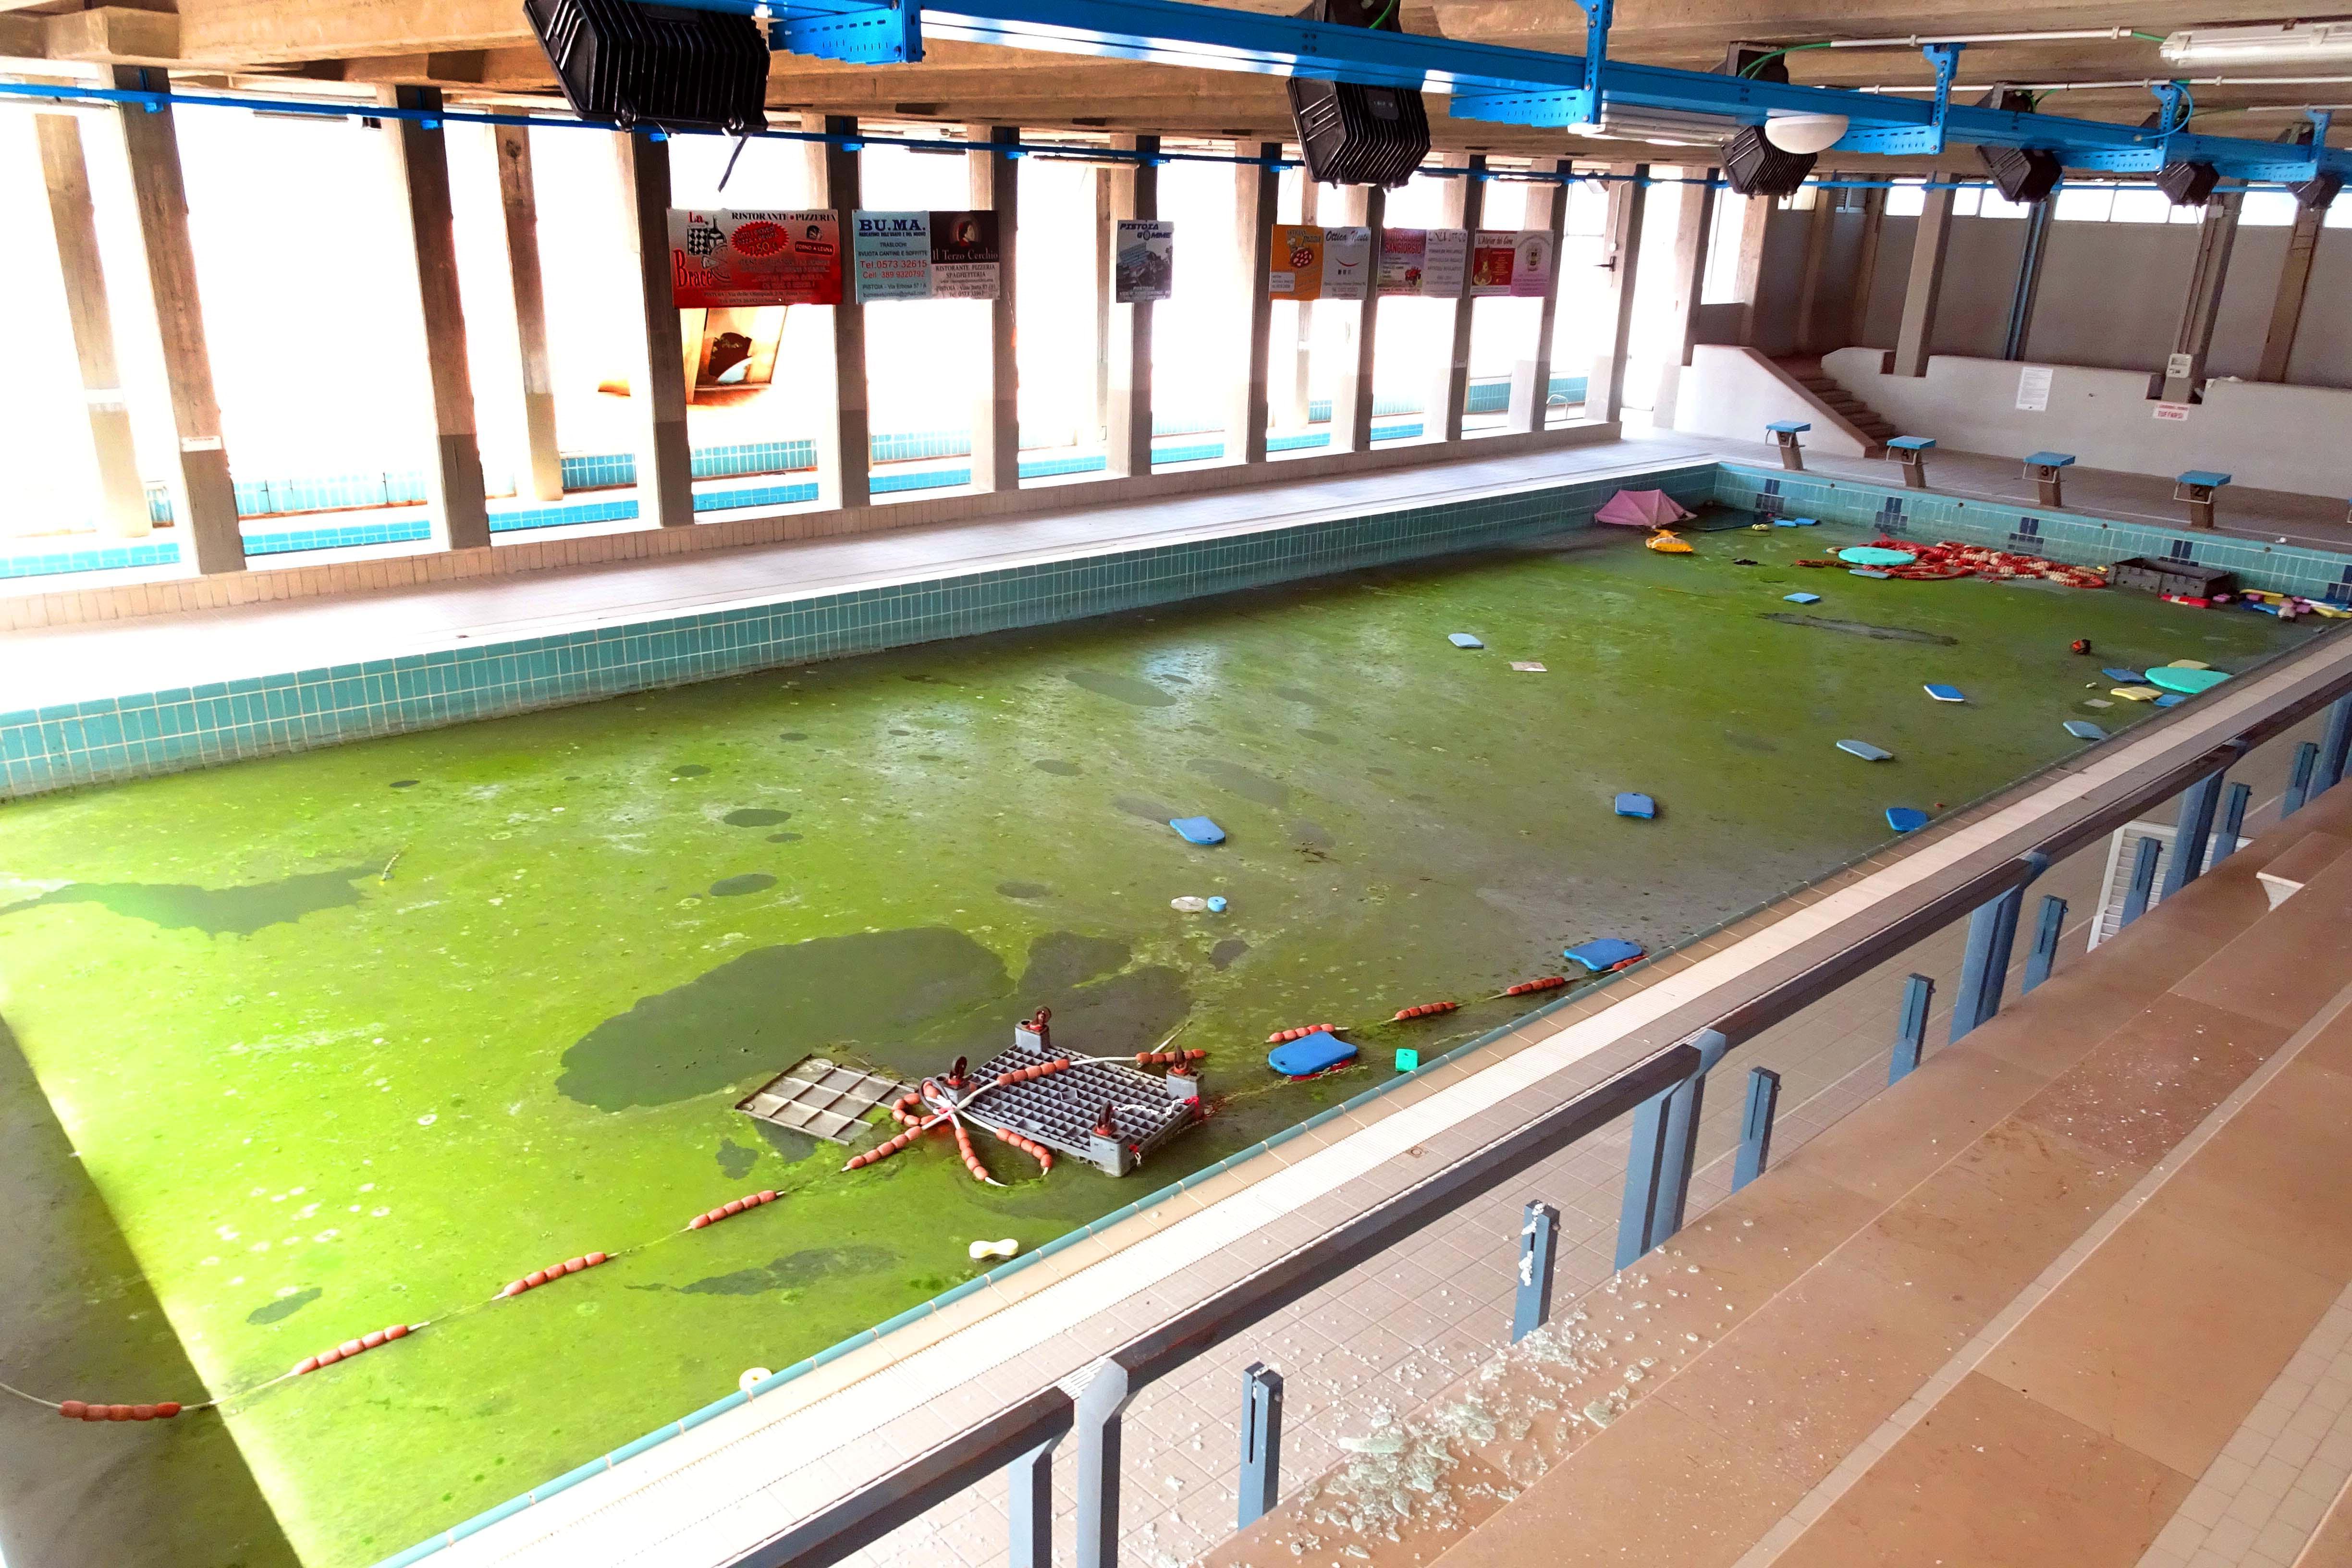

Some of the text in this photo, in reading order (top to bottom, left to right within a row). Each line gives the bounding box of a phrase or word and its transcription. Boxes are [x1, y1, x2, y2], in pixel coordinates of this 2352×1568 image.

[688, 211, 703, 223] La
[732, 212, 787, 220] RISTORANTE
[859, 220, 926, 231] BU.MA.
[1137, 231, 1171, 240] GOMME
[1326, 230, 1347, 241] Ottica
[933, 247, 998, 260] Il Terzo Cerchio
[673, 249, 712, 287] Brace
[1902, 449, 1910, 460] 4
[2041, 465, 2049, 476] 3
[2194, 485, 2203, 497] 2
